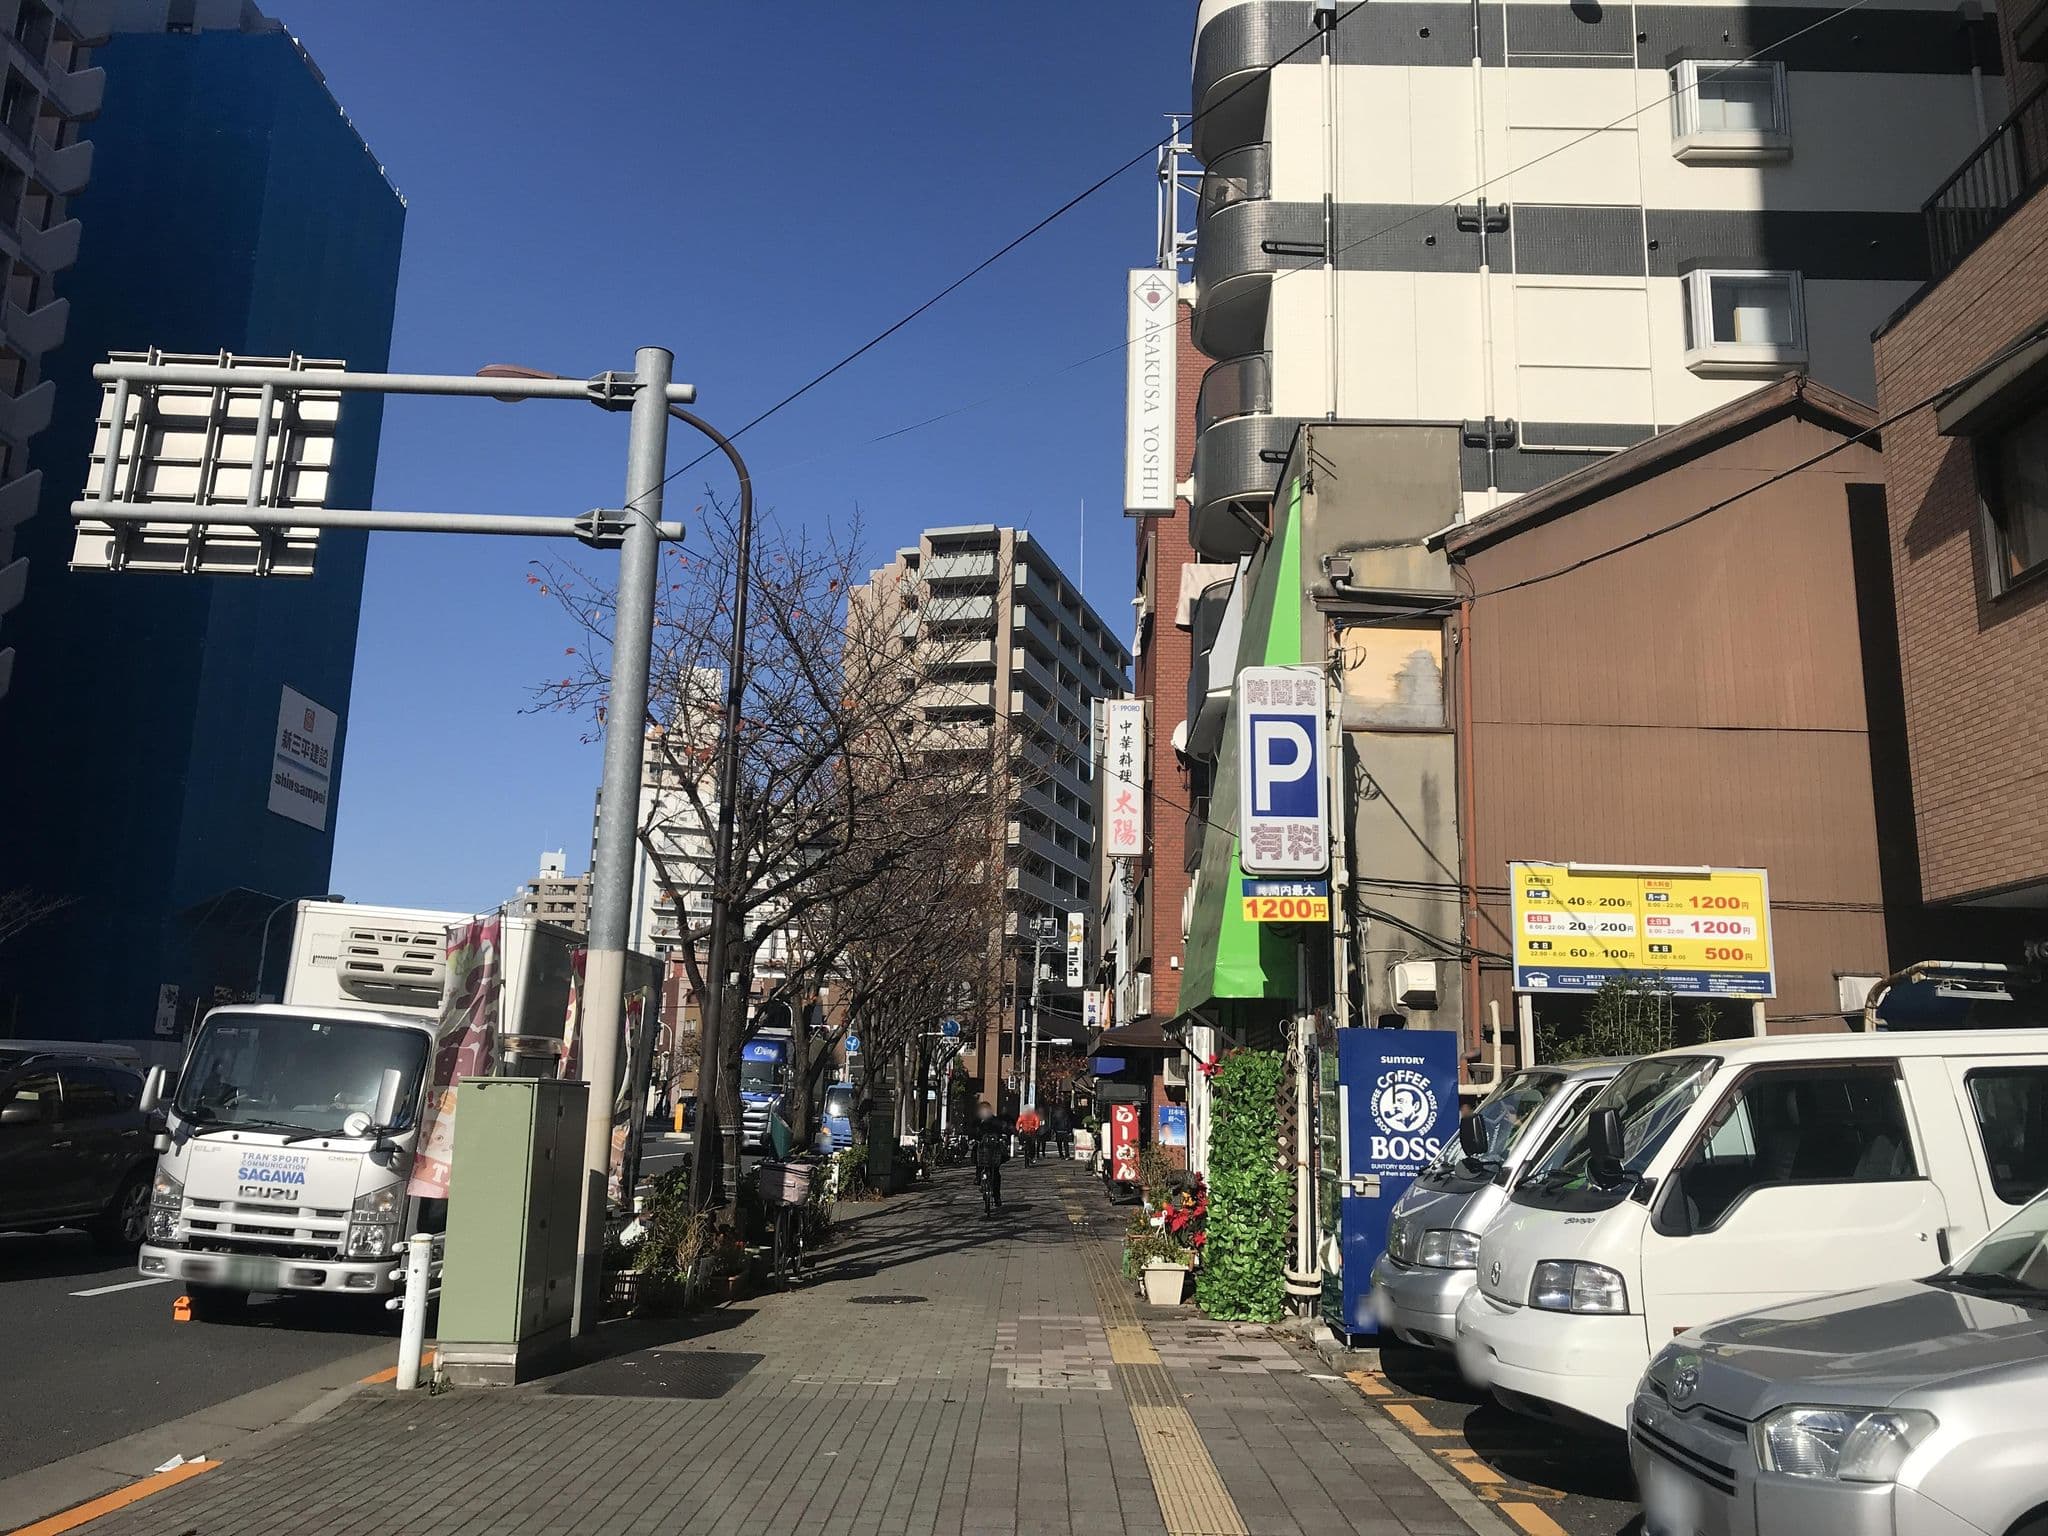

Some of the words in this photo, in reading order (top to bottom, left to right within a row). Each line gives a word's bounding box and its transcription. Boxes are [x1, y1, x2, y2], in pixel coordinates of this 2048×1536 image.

[1144, 319, 1160, 414] ASAKUSA
[1143, 426, 1160, 501] YOSHII
[1120, 720, 1133, 783] 中華料理
[1254, 720, 1312, 810] P
[1113, 790, 1137, 846] 太陽
[1246, 899, 1326, 918] 1200円
[1689, 896, 1749, 910] 1200円
[1690, 921, 1750, 934] 1200円
[1705, 948, 1752, 960] 500円
[1380, 1056, 1426, 1064] SUNTORY
[1377, 1070, 1431, 1090] COFFEE
[1371, 1088, 1382, 1116] COFFEE
[1425, 1090, 1438, 1110] BOSS
[1418, 1111, 1438, 1136] COFFEE
[1370, 1136, 1440, 1160] BOSS
[241, 1160, 306, 1170] COMMUNICATION
[238, 1167, 305, 1184] SAGAWA
[239, 1185, 298, 1200] ISUZU
